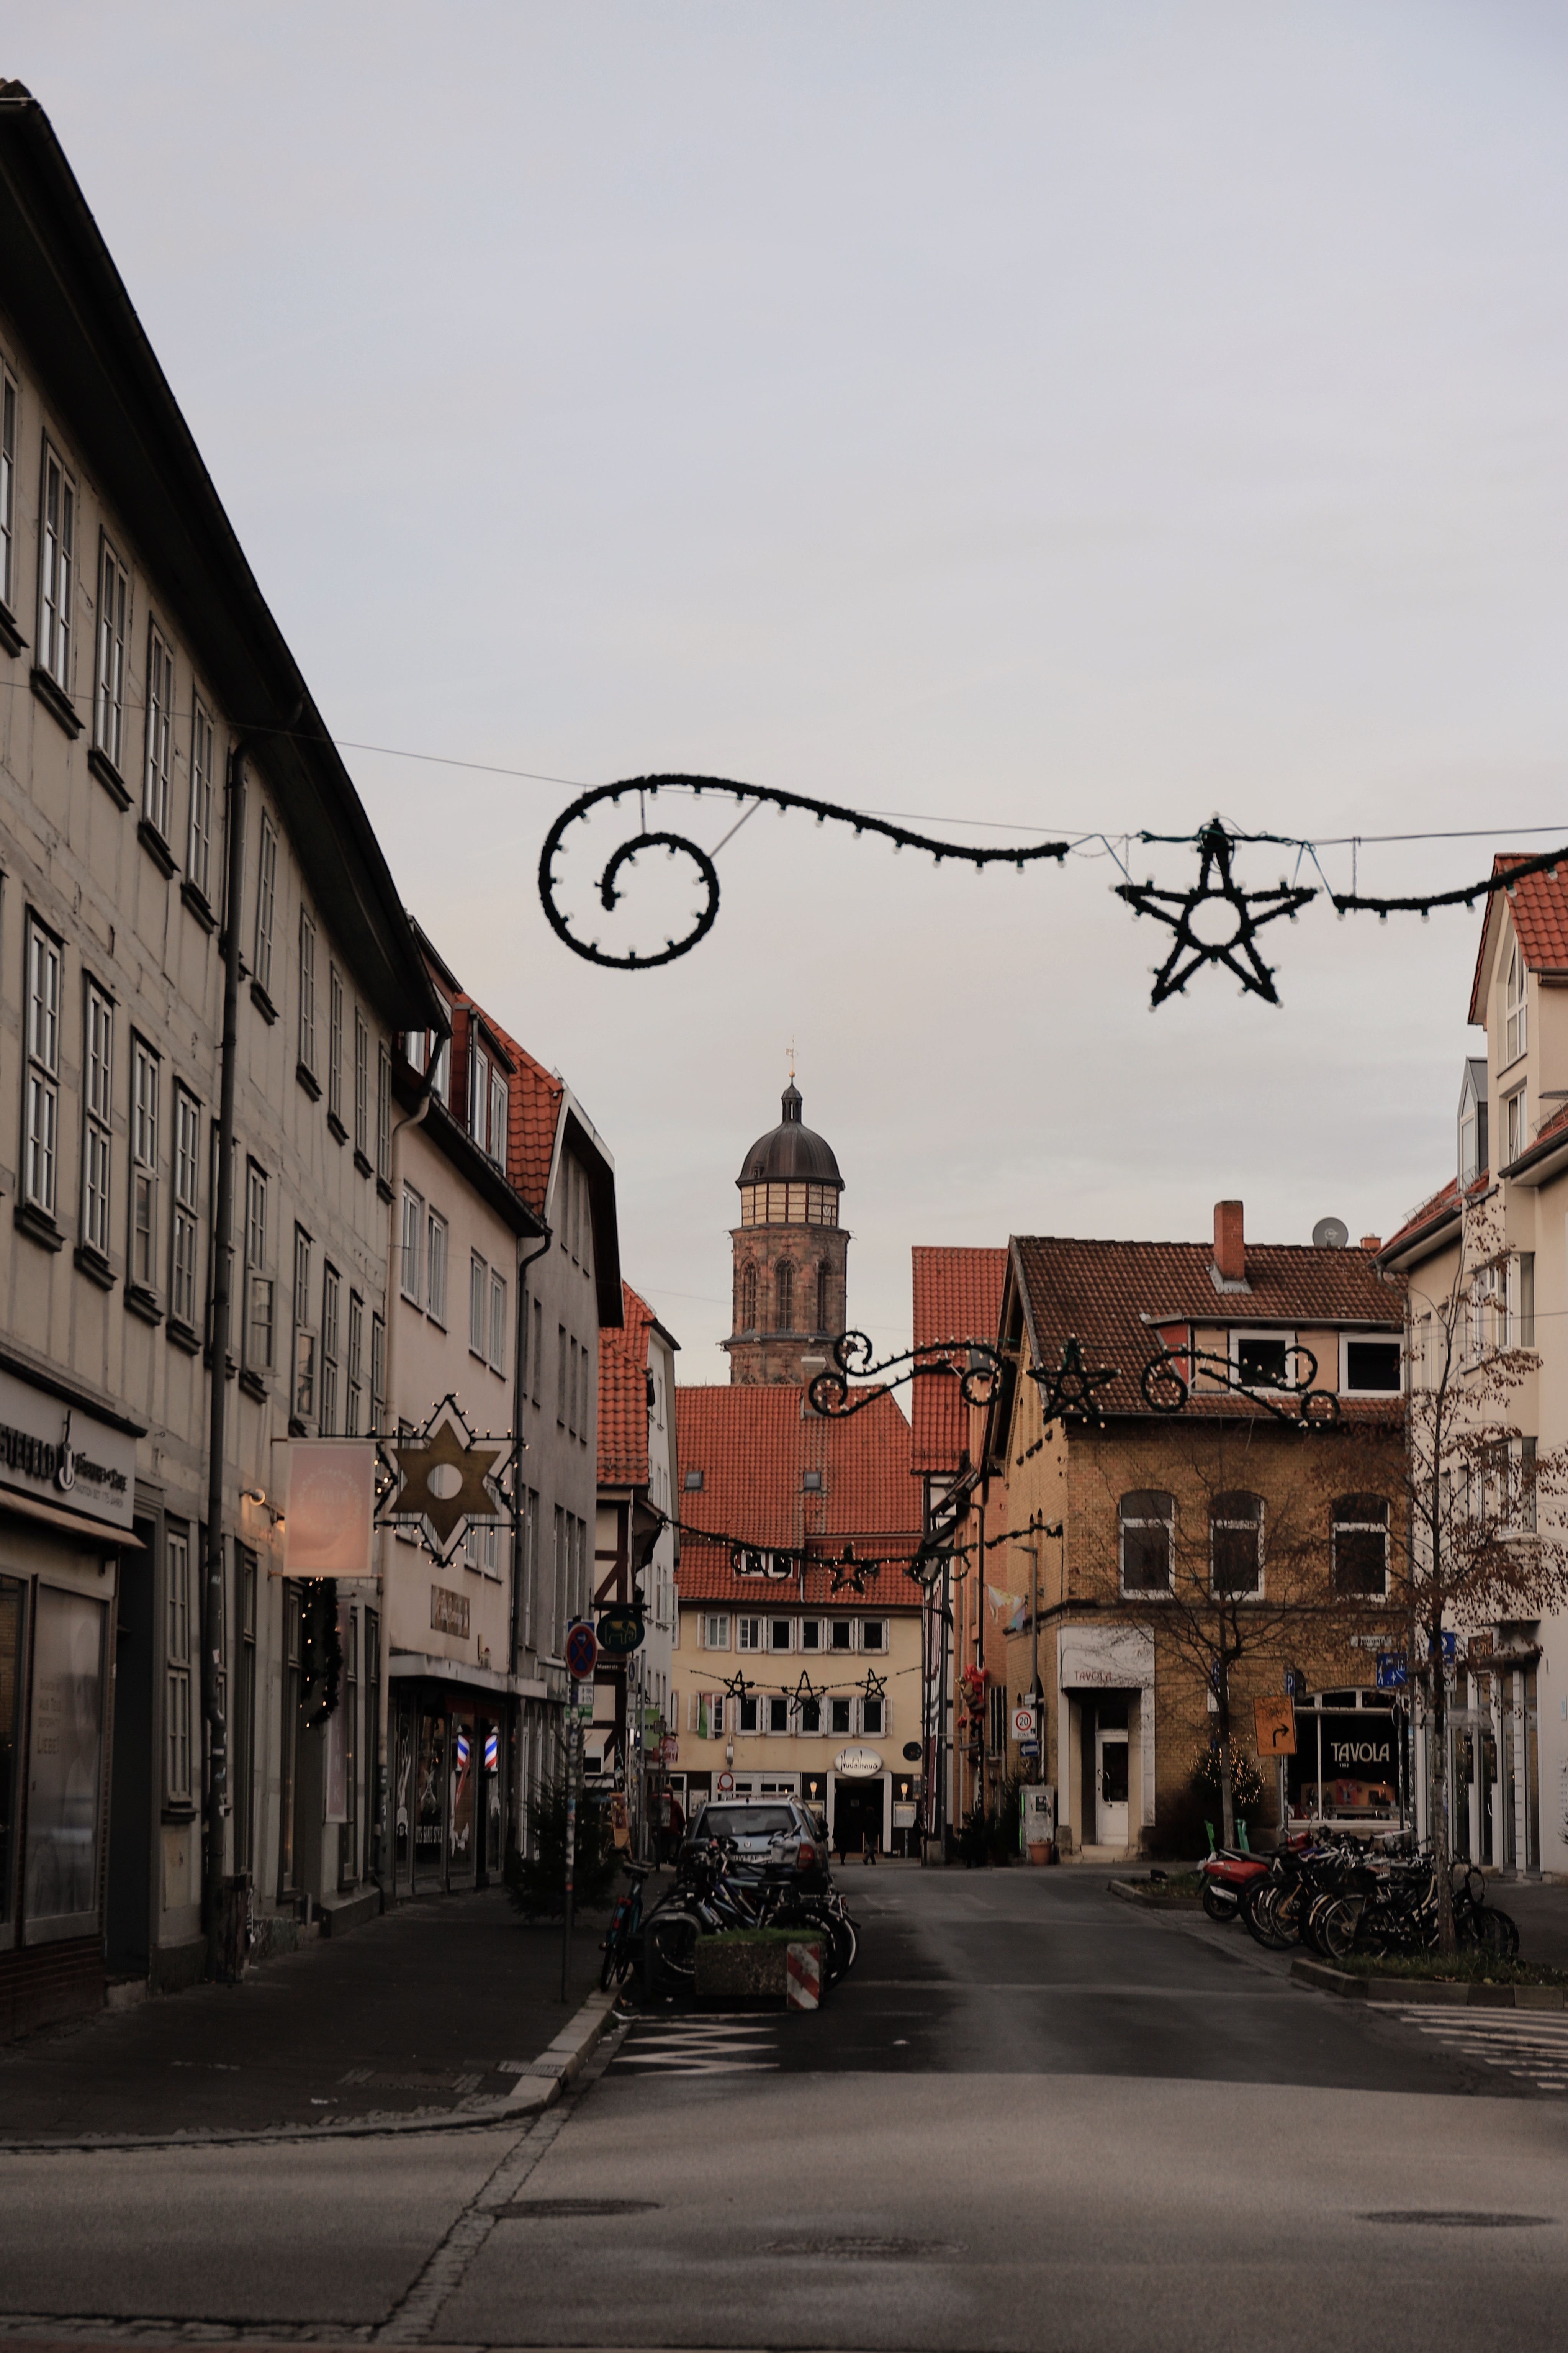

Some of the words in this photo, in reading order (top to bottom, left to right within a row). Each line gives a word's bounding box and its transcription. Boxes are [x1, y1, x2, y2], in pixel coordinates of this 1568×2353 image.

[1075, 1671, 1111, 1681] TAVOLA
[1020, 1717, 1028, 1726] 20
[1331, 1742, 1390, 1763] TAVOLA
